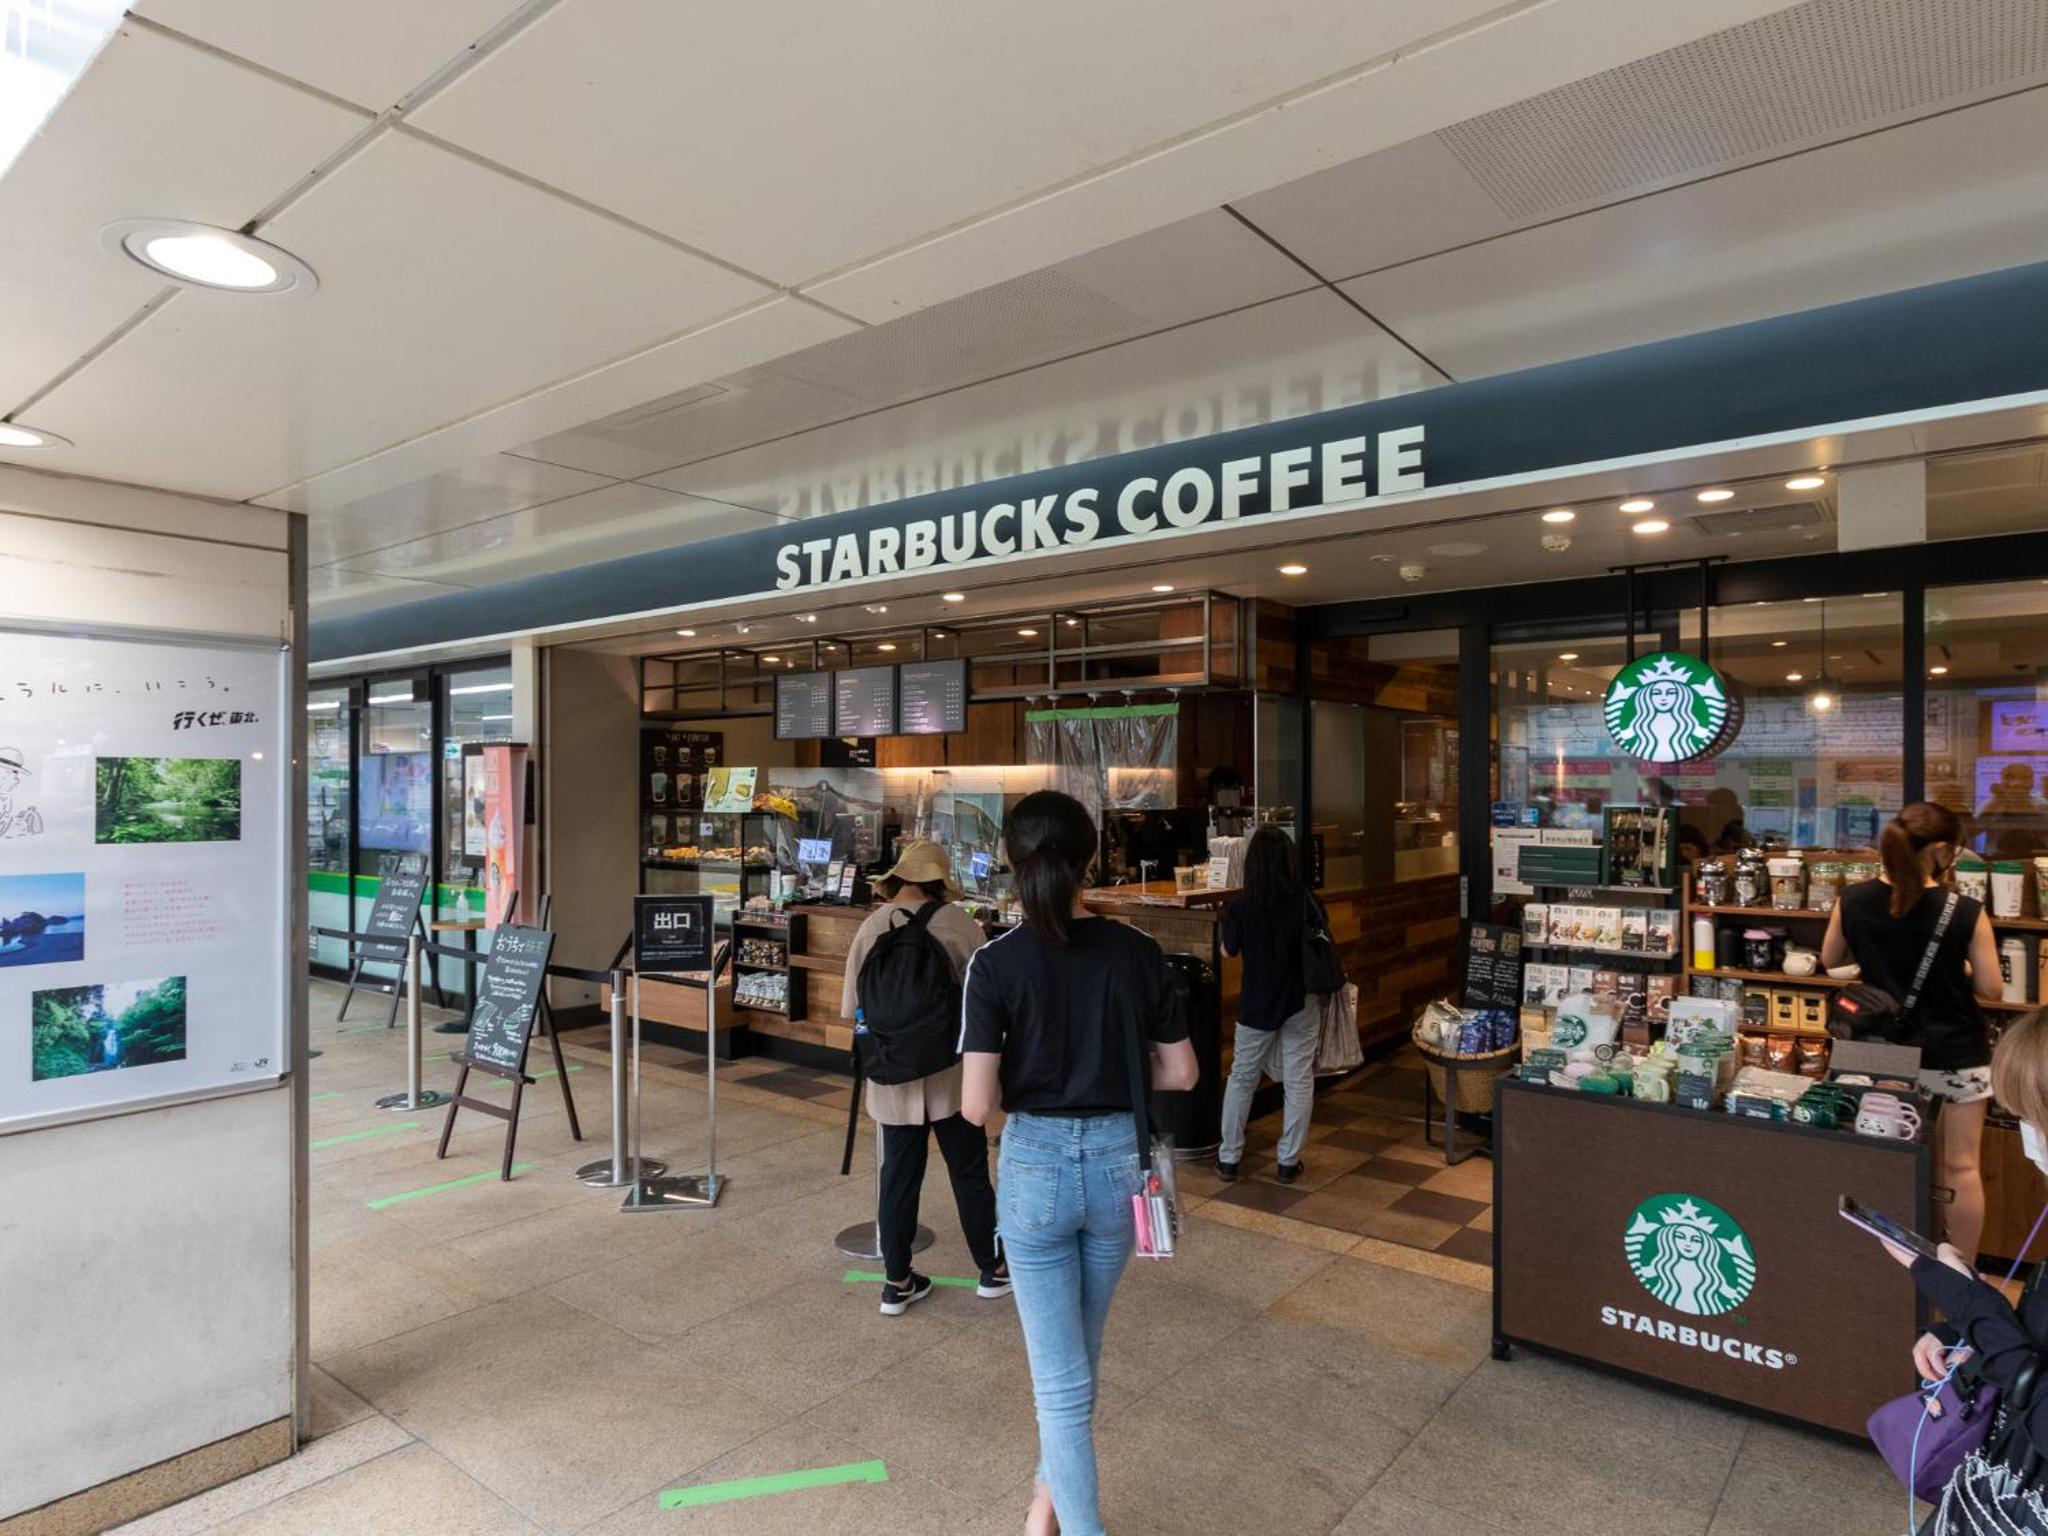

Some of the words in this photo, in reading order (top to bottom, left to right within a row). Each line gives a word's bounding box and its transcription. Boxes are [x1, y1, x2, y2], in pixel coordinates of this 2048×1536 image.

[776, 487, 1100, 591] STARBUCKS
[1116, 424, 1427, 534] COFFEE
[653, 911, 691, 930] 出口
